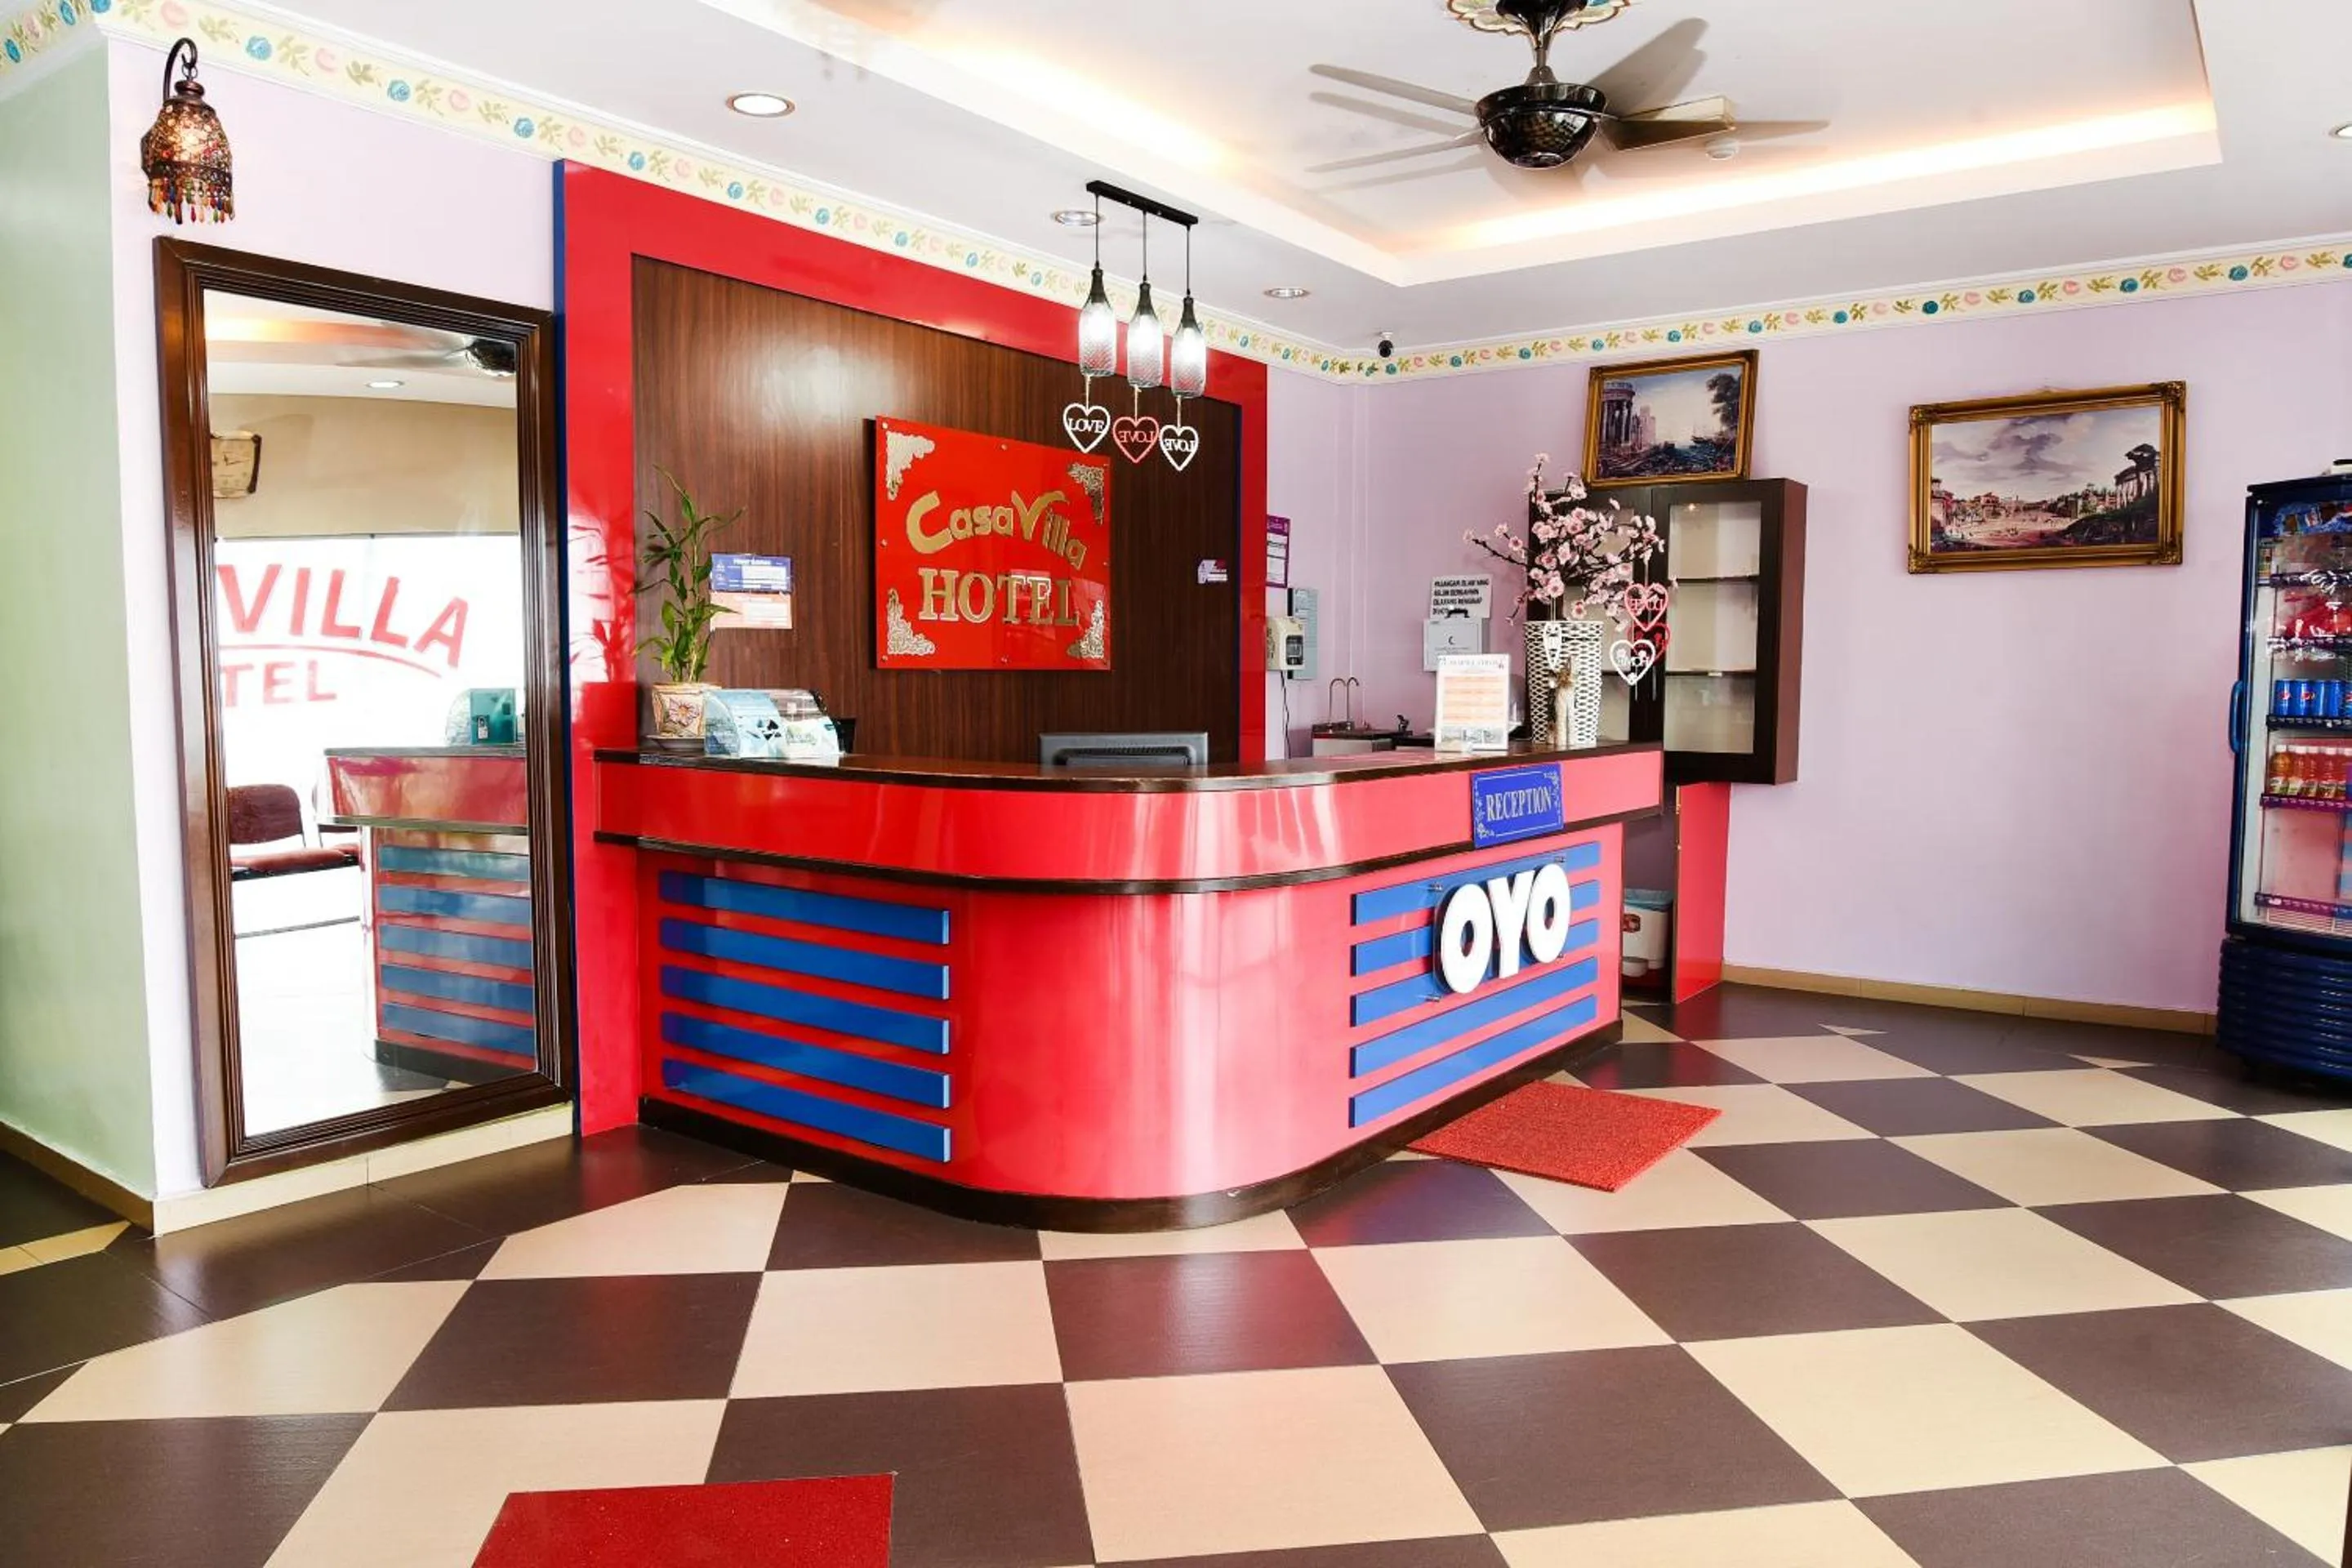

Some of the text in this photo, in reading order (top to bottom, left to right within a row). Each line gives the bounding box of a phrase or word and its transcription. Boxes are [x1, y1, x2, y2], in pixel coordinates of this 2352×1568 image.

[1067, 417, 1105, 434] LOVE
[216, 564, 469, 668] VILLA
[917, 567, 1080, 626] HOTEL
[1486, 786, 1552, 822] RECEPTION
[1439, 863, 1571, 994] OYO
